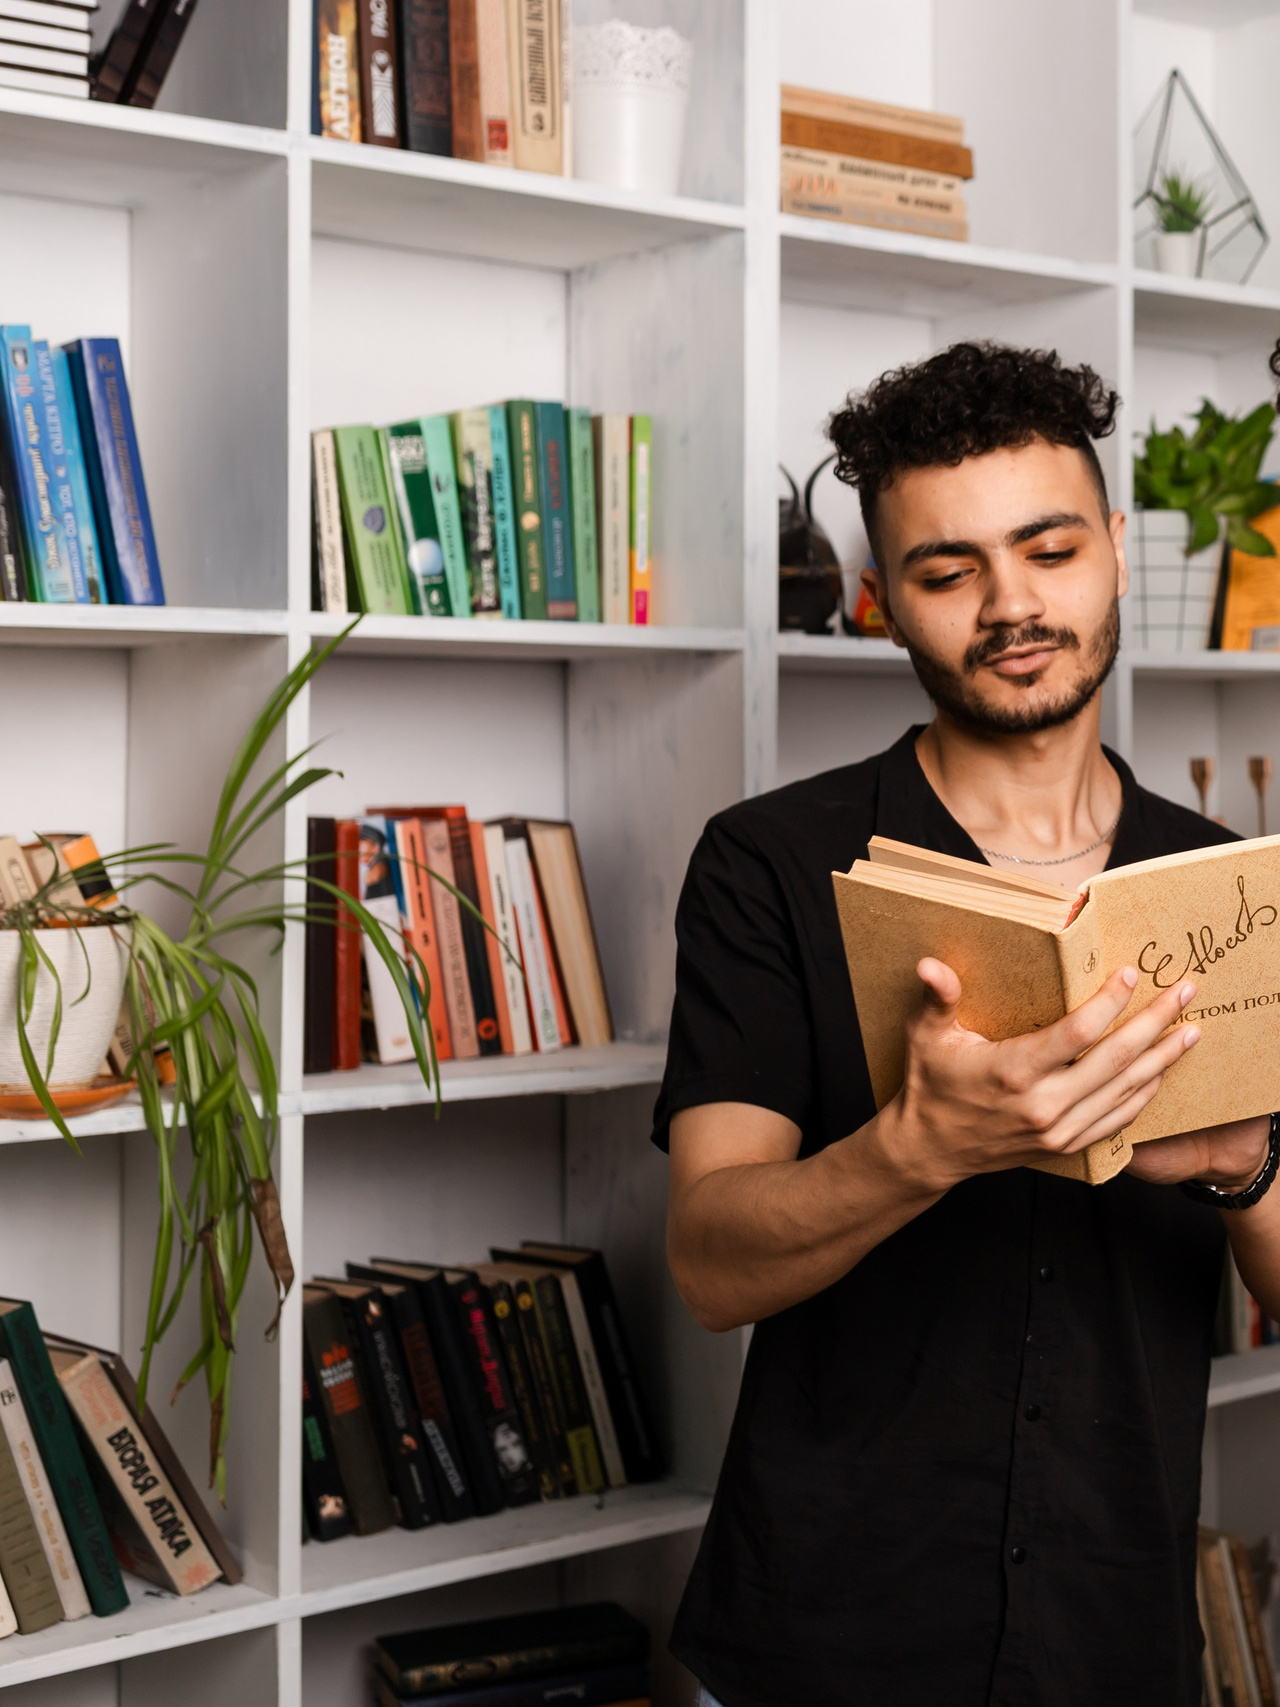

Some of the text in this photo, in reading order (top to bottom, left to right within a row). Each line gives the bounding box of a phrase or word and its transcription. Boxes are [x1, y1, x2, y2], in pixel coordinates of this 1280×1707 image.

[327, 33, 351, 139] ЛЕГИОН
[1172, 1001, 1237, 1025] ИСТОМ
[106, 1426, 192, 1559] ВТОРАЯ АТАКА
